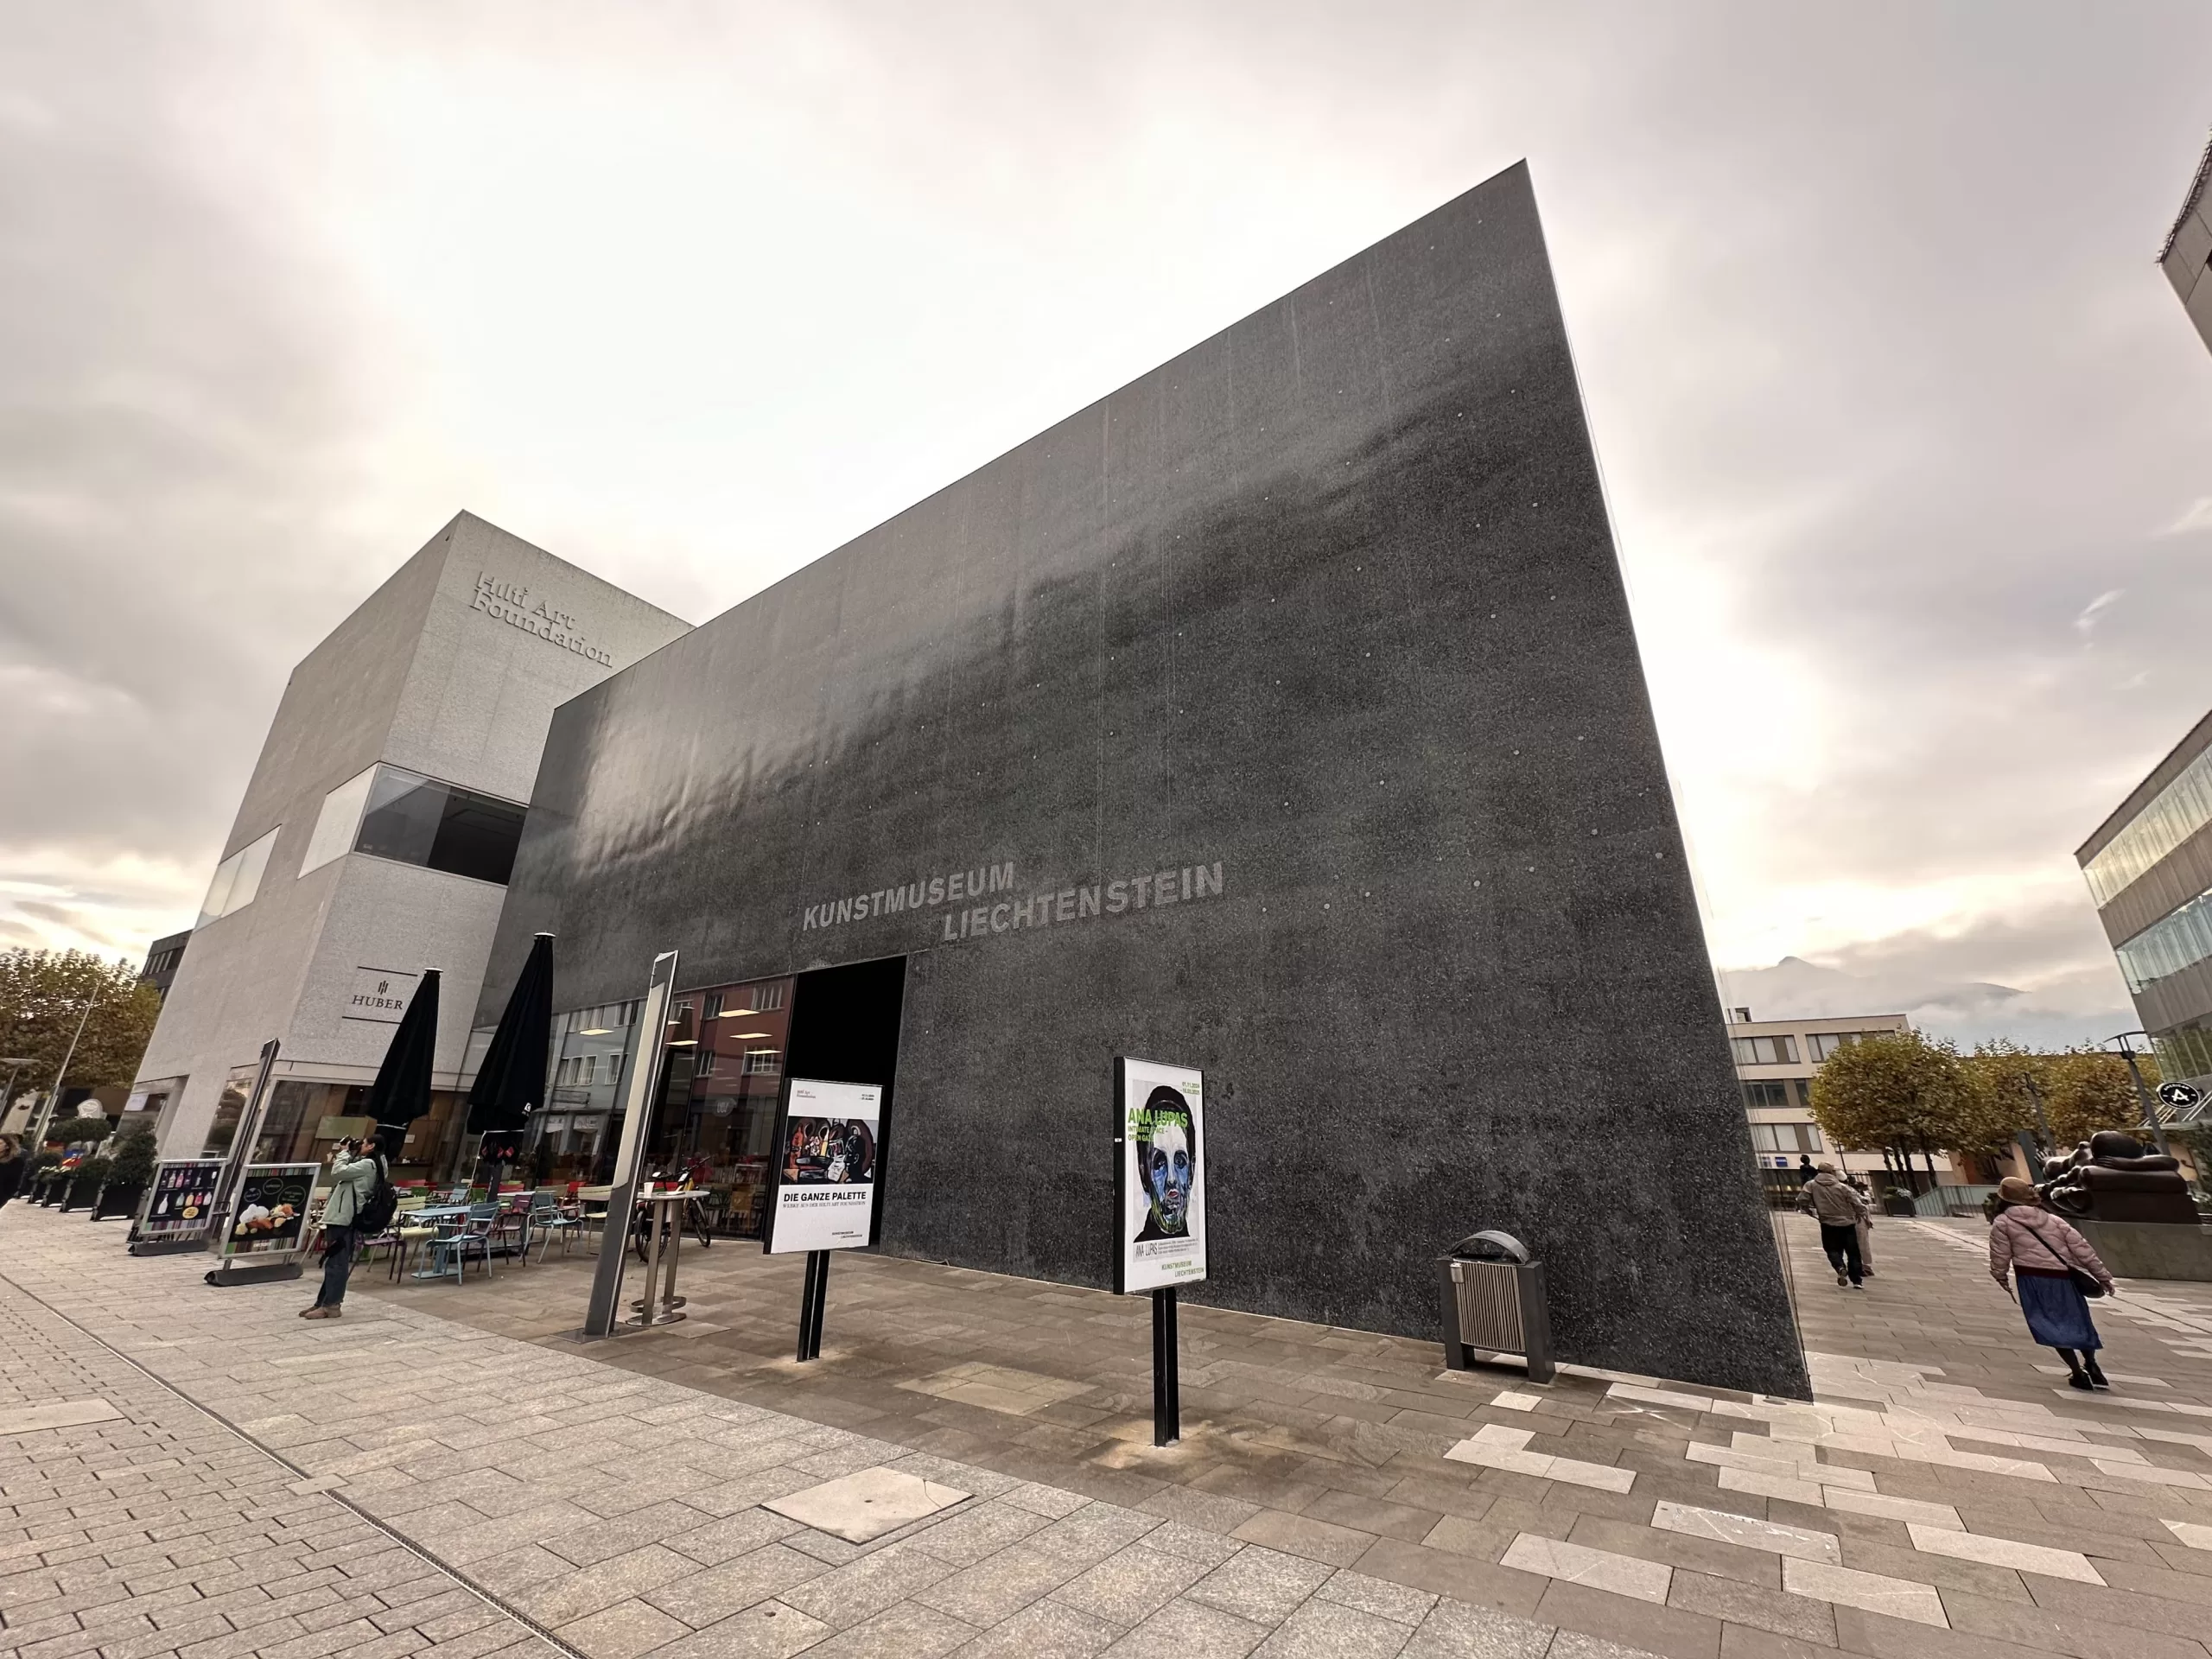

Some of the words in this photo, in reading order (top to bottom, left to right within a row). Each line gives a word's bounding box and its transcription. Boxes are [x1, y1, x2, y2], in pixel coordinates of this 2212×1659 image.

[475, 570, 529, 609] Hilti
[531, 601, 577, 630] Art
[469, 588, 613, 668] Foundation
[803, 861, 1015, 931] KUNSTMUSEUM
[943, 861, 1224, 942] LIECHTENSTEIN
[352, 995, 404, 1010] HUBER
[1128, 1108, 1153, 1124] ANA
[1154, 1109, 1188, 1128] LUPAS
[784, 1193, 799, 1202] DIE
[801, 1192, 830, 1201] GANZE
[832, 1192, 867, 1200] PALETTE
[1135, 1244, 1144, 1258] ANA
[1145, 1243, 1158, 1256] LUPAS
[1161, 1261, 1192, 1270] KUNSTMUSEUM
[1175, 1268, 1205, 1277] LIECHTENSTEIN
